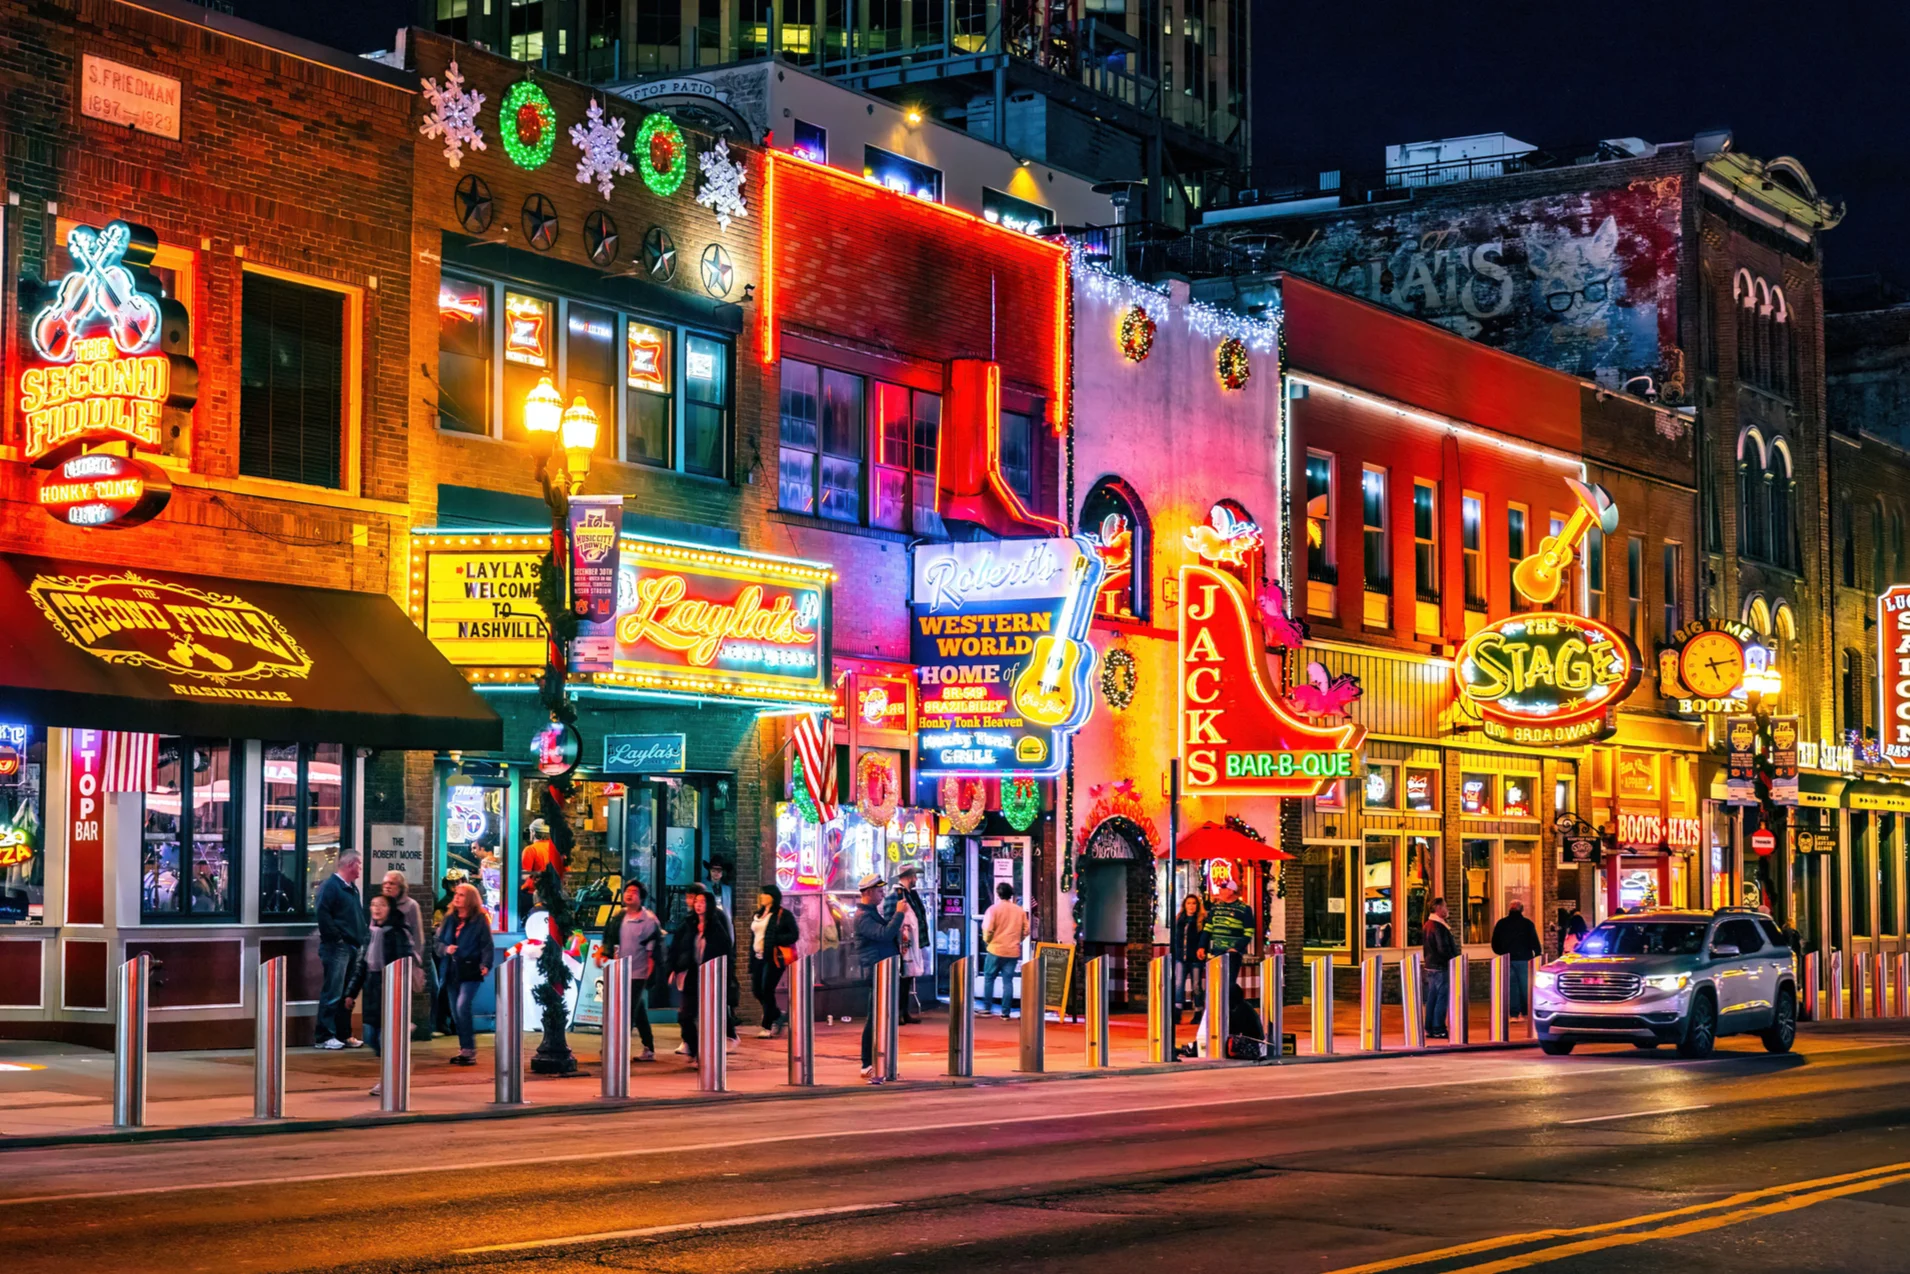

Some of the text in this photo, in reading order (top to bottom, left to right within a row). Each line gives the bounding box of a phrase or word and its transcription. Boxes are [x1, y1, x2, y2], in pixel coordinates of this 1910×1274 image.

[673, 82, 712, 95] PATIO
[73, 337, 113, 361] THE
[21, 356, 170, 412] SECOND
[26, 397, 161, 457] FIDDLE
[40, 479, 140, 503] HONKY TONK
[466, 562, 540, 579] LAYLA'S
[927, 543, 1063, 613] Robert's
[132, 588, 160, 600] THE
[492, 603, 512, 618] TO
[615, 575, 815, 666] Layla's
[50, 592, 297, 662] SECOND FIDDLE
[458, 622, 546, 639] NASHVILLE
[919, 611, 1052, 636] WESTERN
[1525, 618, 1559, 635] THE
[1674, 618, 1753, 643] BIG TIME
[936, 635, 1033, 658] WORLD
[921, 662, 1020, 687] HOME of
[1467, 631, 1624, 701] STAGE
[169, 683, 293, 702] NASHVILLE
[1185, 585, 1228, 786] JACKS
[1678, 699, 1748, 713] BOOTS
[919, 715, 1023, 731] Honky Tonk Heaven
[1485, 719, 1601, 743] ON BROADWAY
[608, 743, 680, 767] Layla's
[941, 749, 998, 764] GRILL
[1226, 753, 1352, 778] BAR-B-QUE
[75, 821, 98, 841] BAR
[392, 837, 405, 846] THE
[1617, 815, 1701, 845] BOOTS HATS
[372, 850, 422, 860] ROBERT MOORE
[1211, 866, 1230, 879] OPEN
